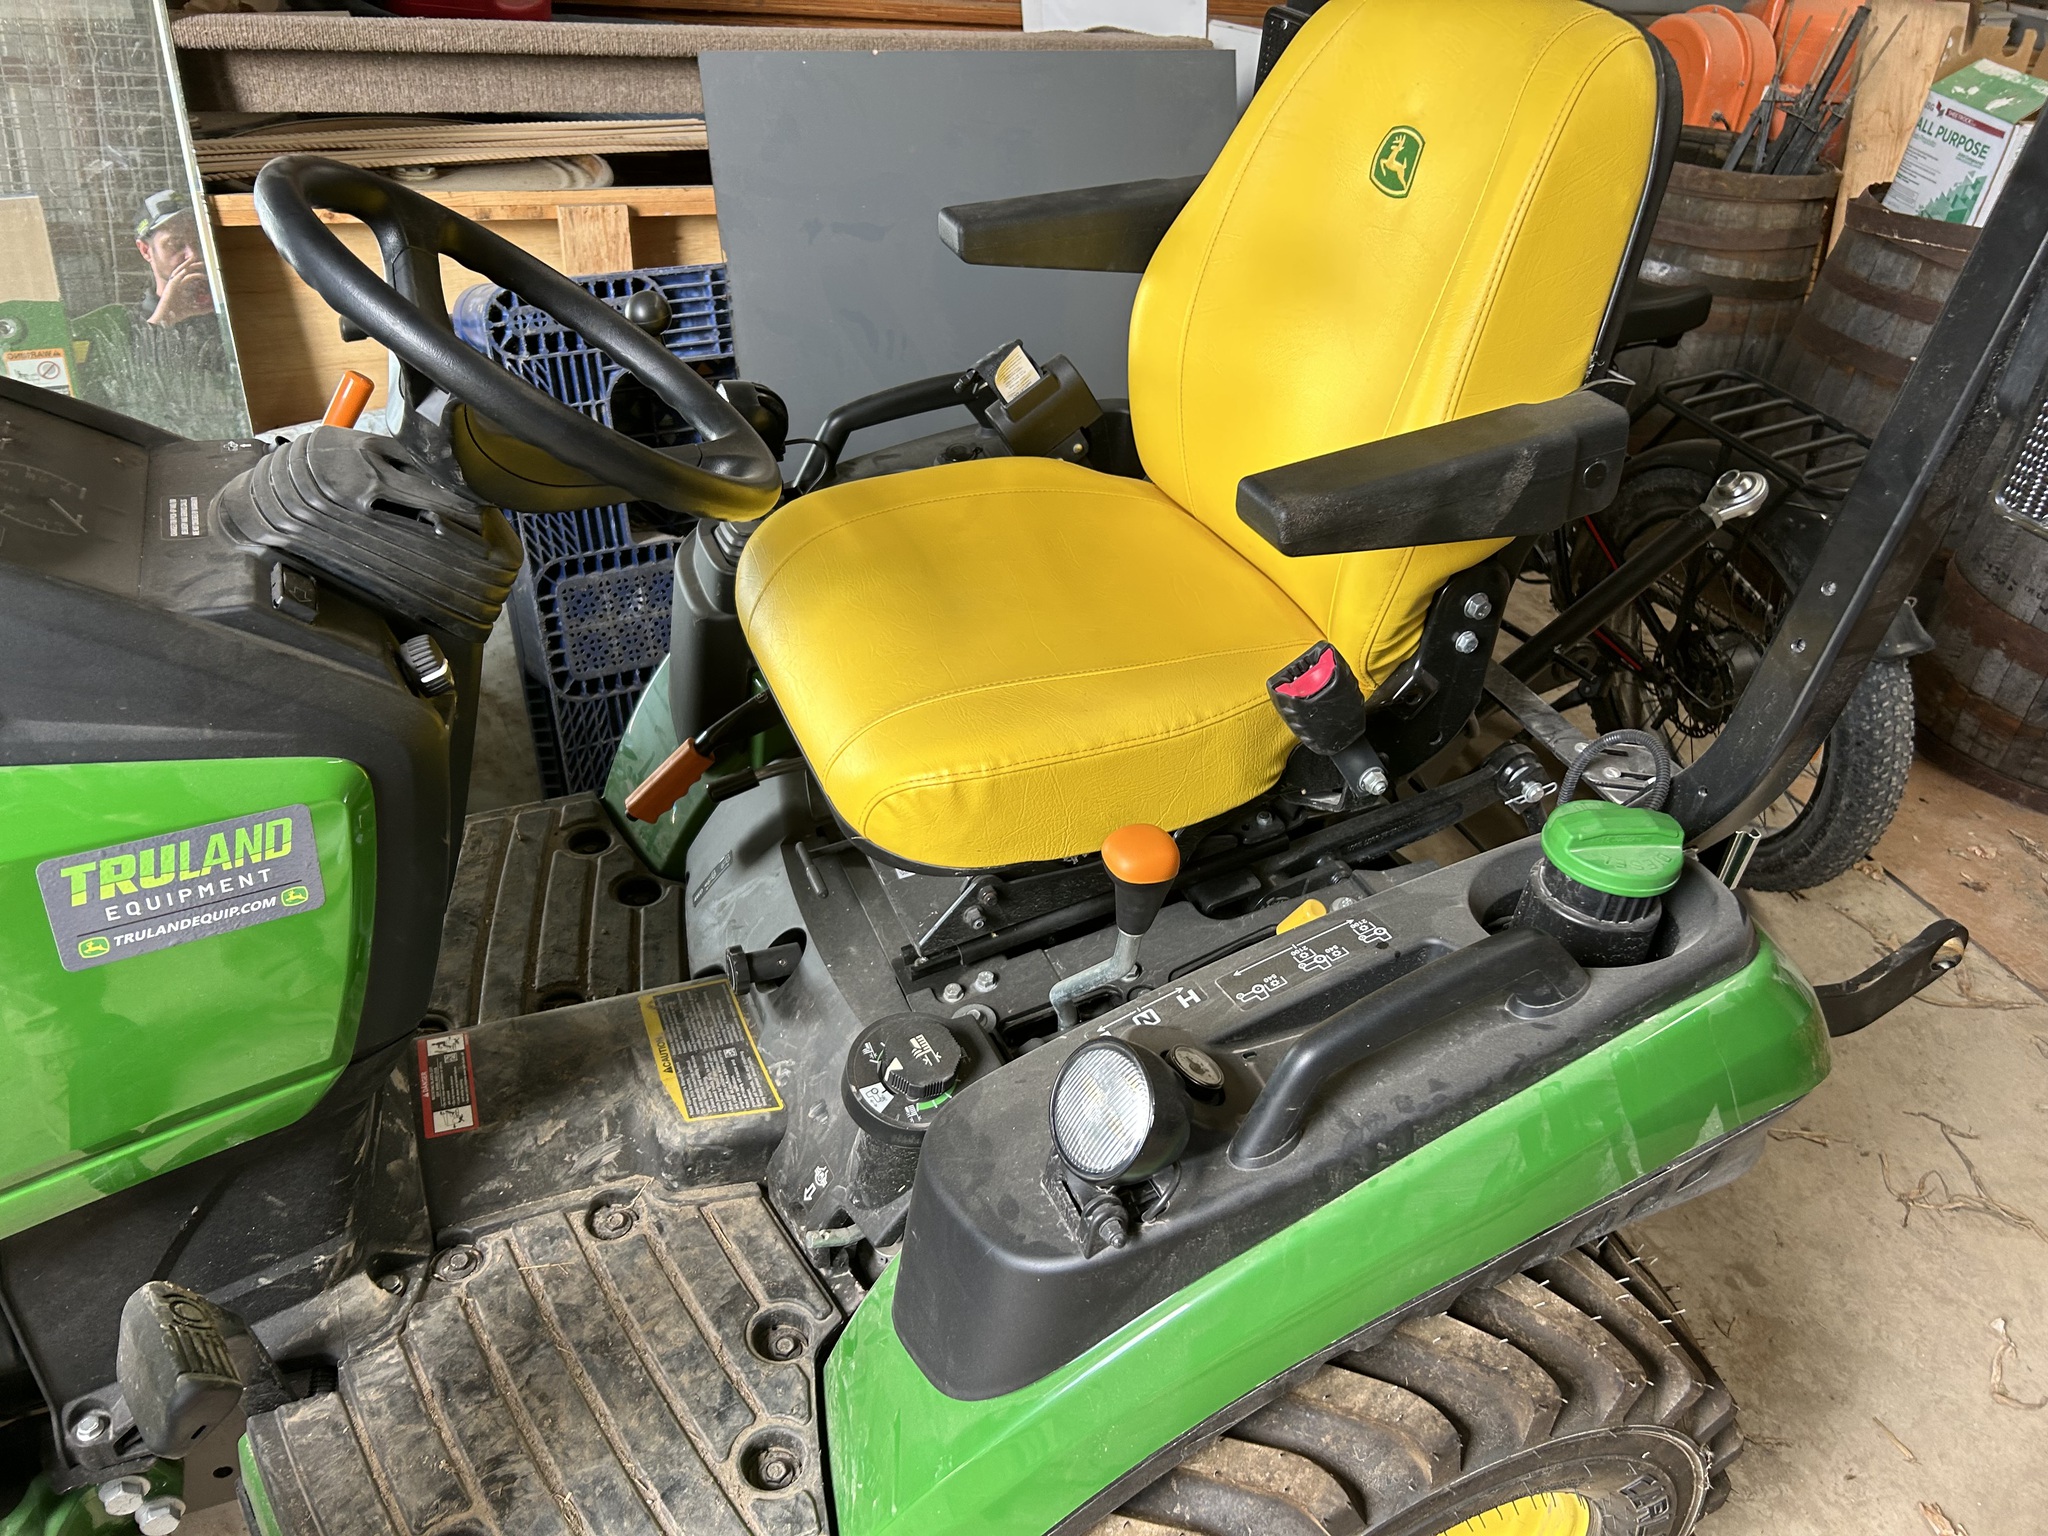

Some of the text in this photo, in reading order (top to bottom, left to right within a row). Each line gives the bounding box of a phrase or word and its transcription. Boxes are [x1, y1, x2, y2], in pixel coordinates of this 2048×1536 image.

[1916, 116, 1932, 136] ALL
[1936, 125, 1990, 160] PURPOSE
[60, 817, 292, 907] TRULAND
[1600, 852, 1672, 871] DIESEL
[104, 868, 272, 922] EQUIPMENT
[113, 896, 276, 947] TRULANDEQUIP.COM
[1177, 988, 1201, 1008] H
[658, 1036, 670, 1069] CAUTION
[420, 1072, 429, 1093] DANGER
